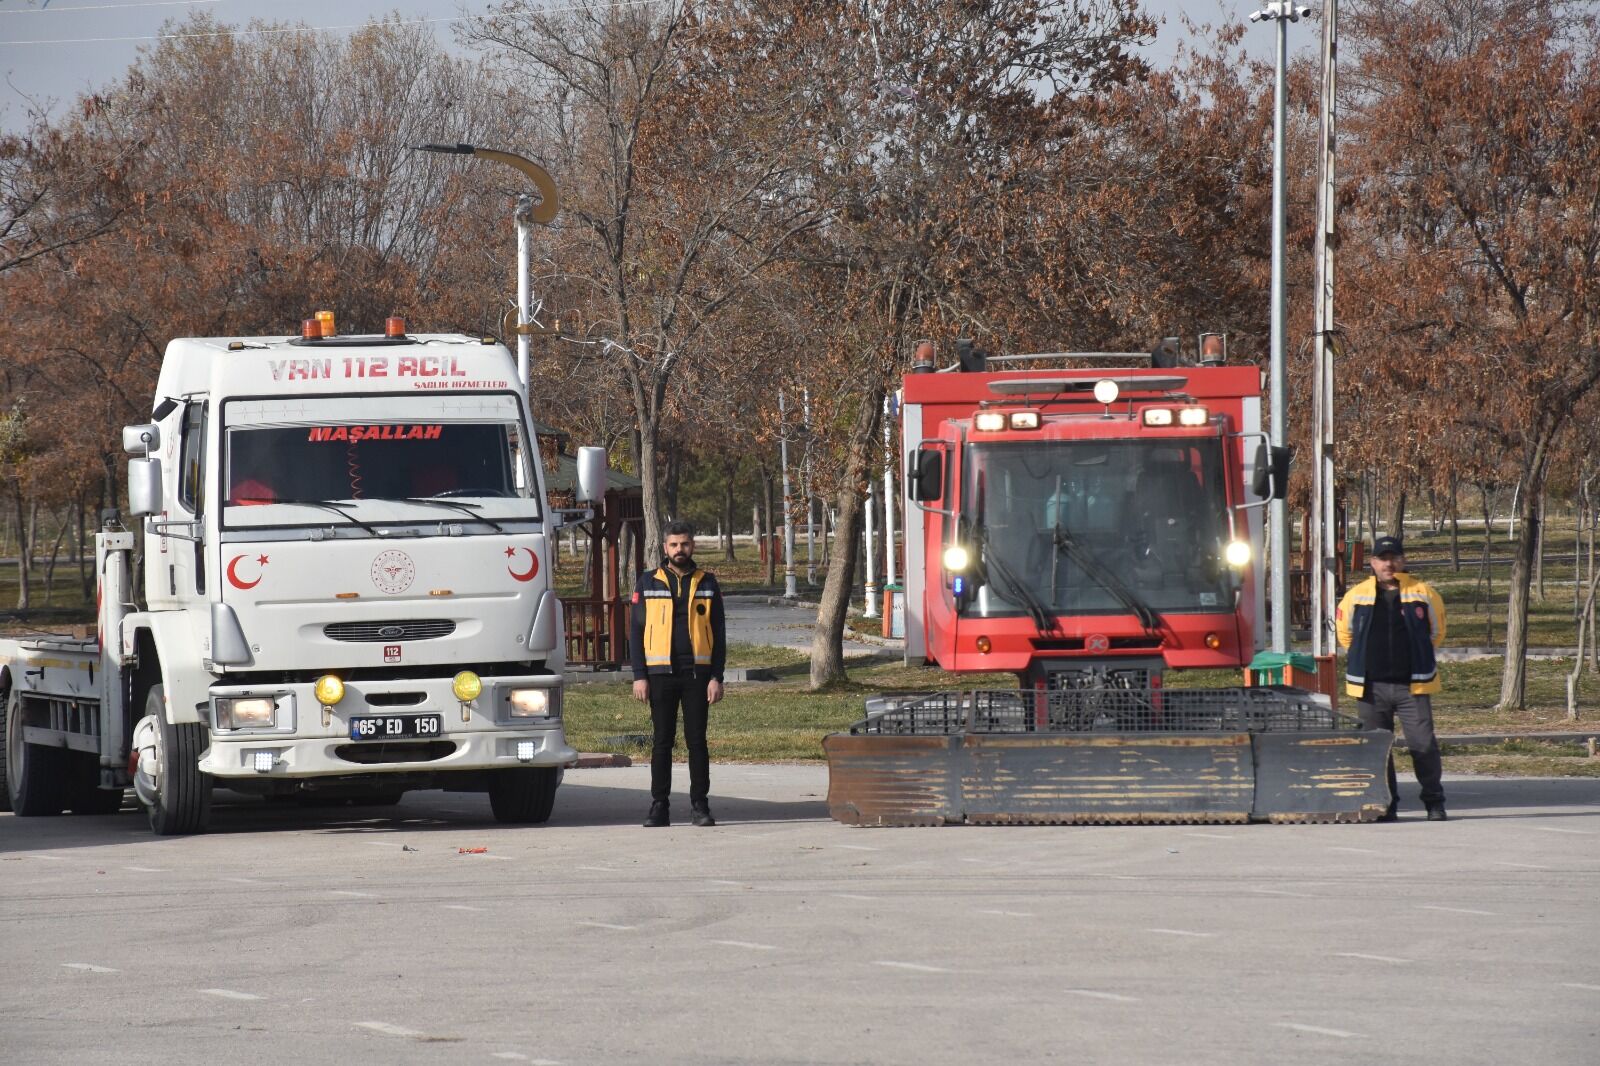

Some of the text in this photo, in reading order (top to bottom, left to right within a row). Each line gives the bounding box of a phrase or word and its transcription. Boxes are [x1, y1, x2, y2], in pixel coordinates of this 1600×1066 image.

[267, 358, 332, 381] VAN
[342, 357, 388, 378] 112
[308, 424, 443, 444] MAŞALLAH
[386, 647, 399, 656] 112
[359, 717, 438, 735] 65 ED 150
